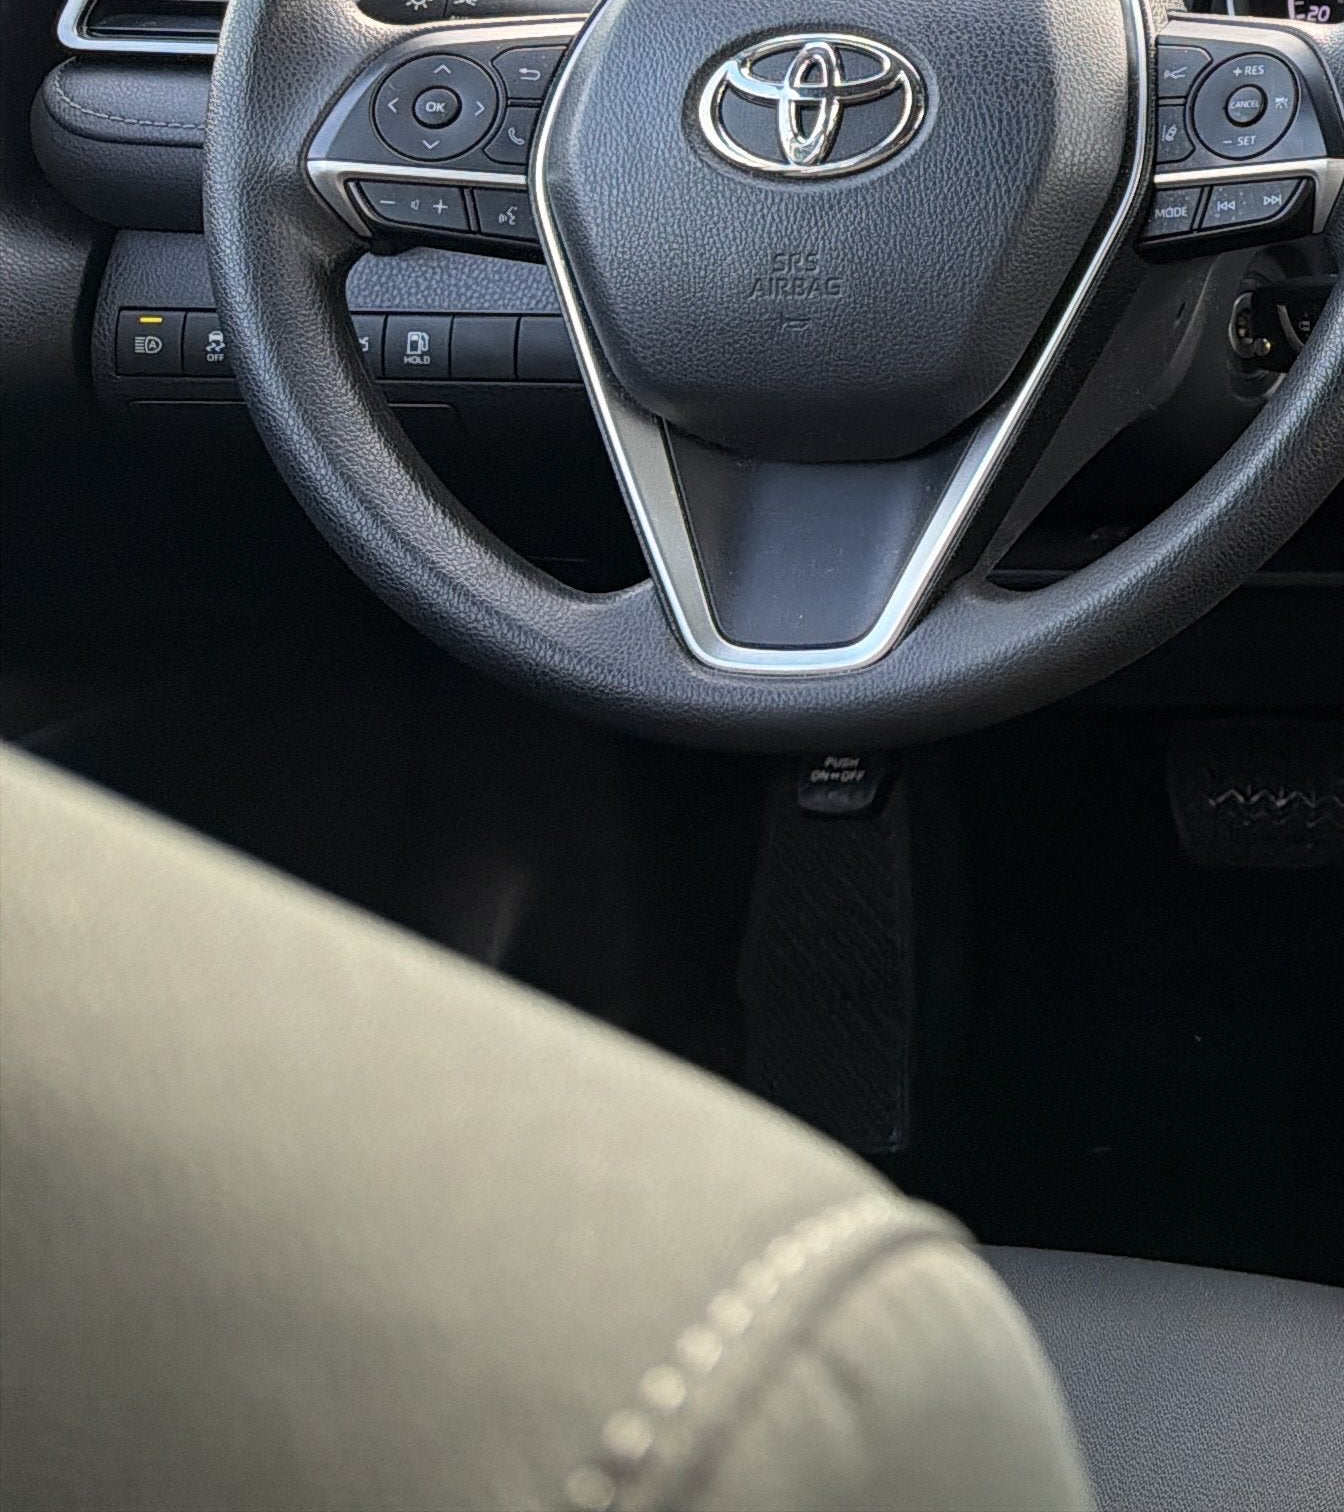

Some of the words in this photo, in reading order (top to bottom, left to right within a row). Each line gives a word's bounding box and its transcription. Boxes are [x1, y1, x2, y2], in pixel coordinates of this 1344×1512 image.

[1307, 5, 1331, 22] 20
[425, 102, 445, 112] OK
[1230, 100, 1260, 109] CANCEL
[1237, 136, 1256, 147] SET
[1155, 206, 1187, 218] MODE
[207, 354, 224, 362] OFF
[404, 355, 430, 364] HOLD
